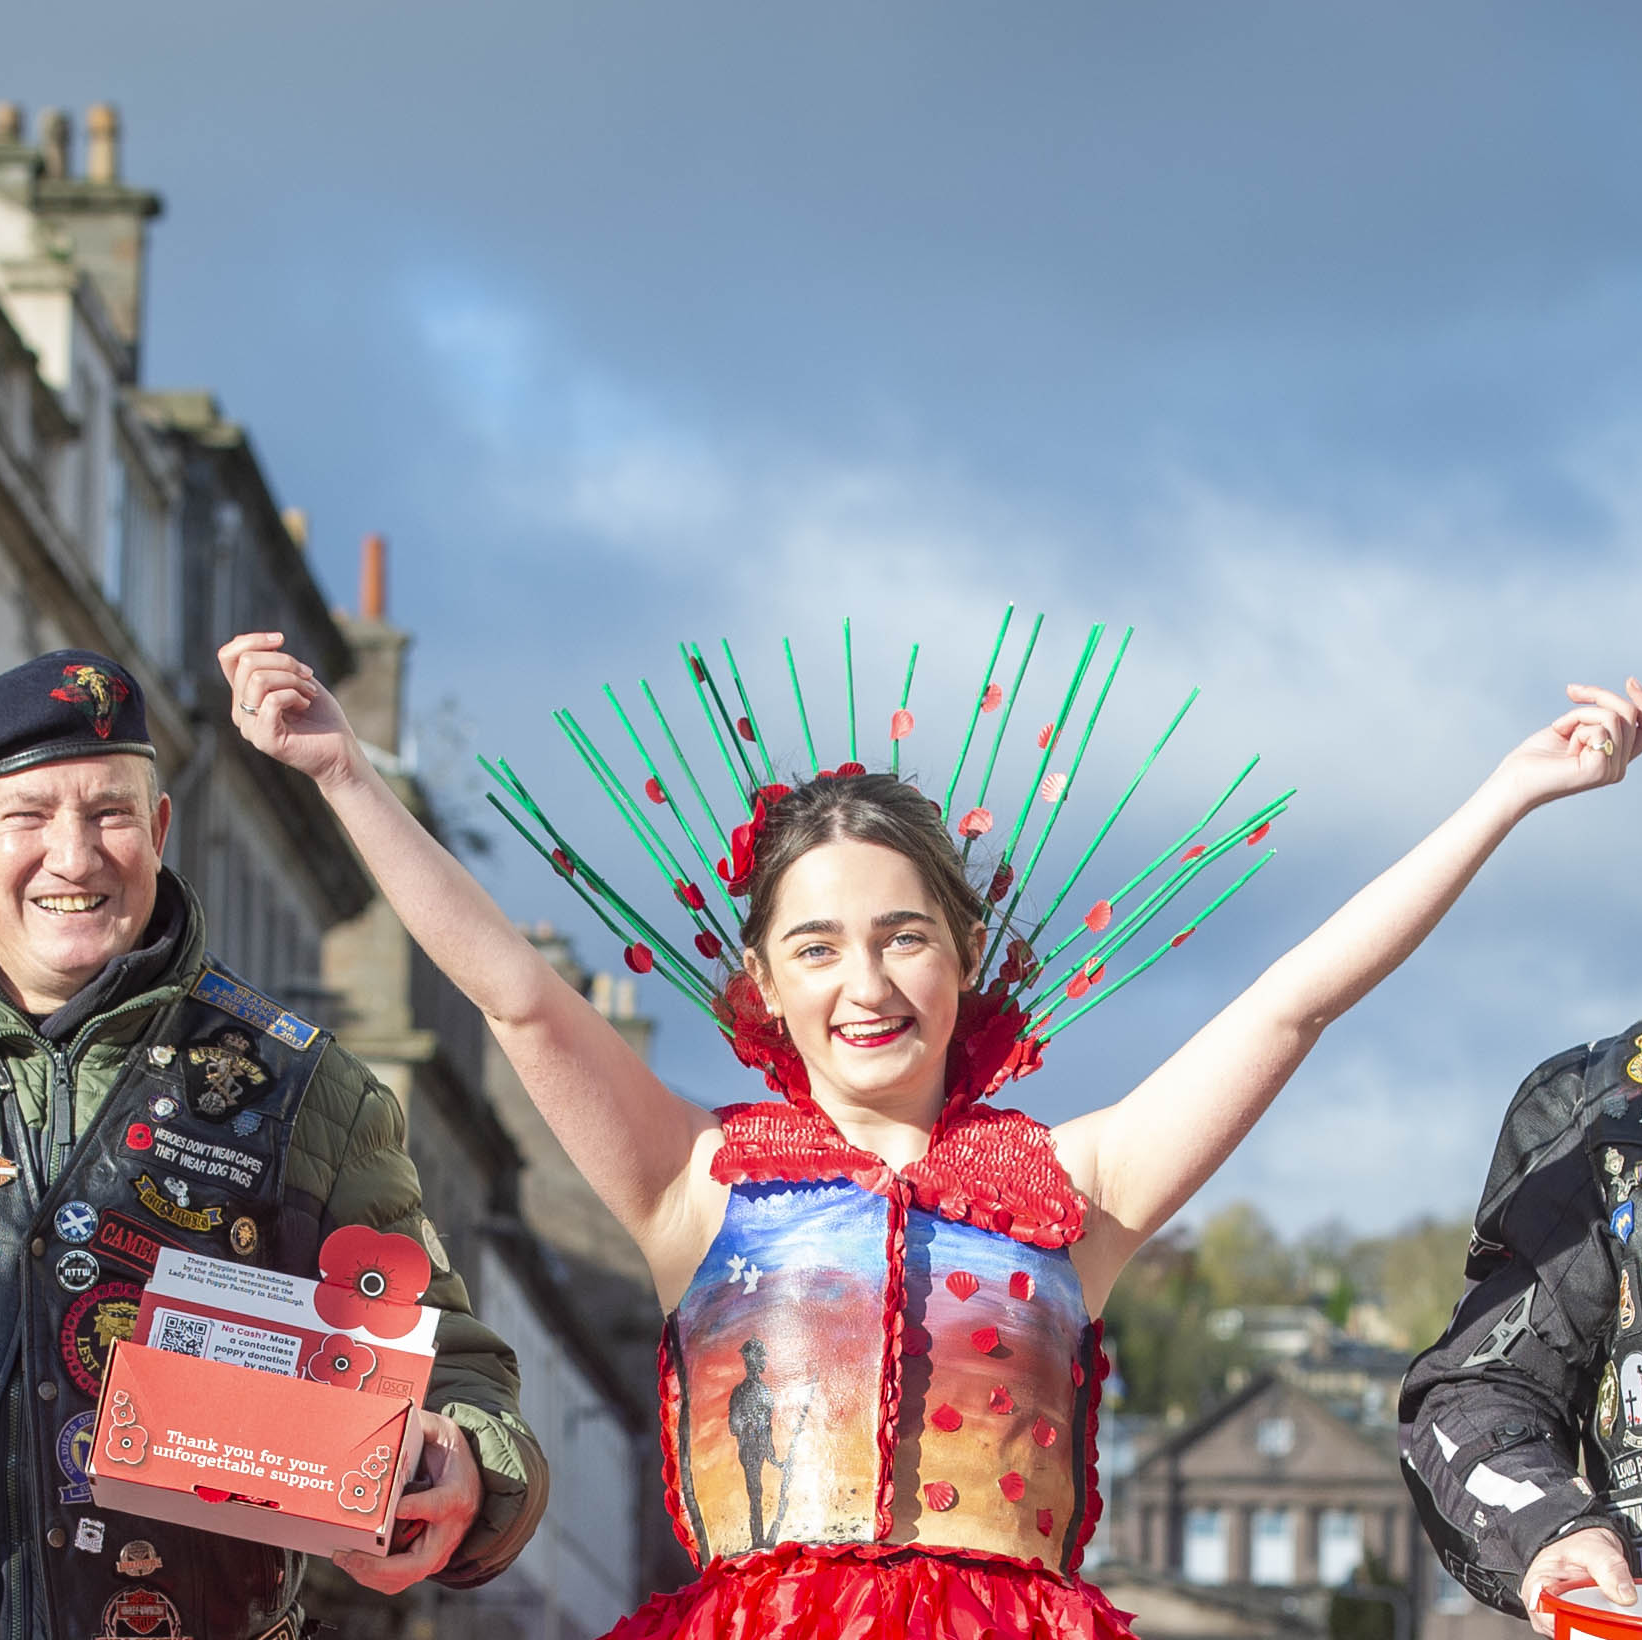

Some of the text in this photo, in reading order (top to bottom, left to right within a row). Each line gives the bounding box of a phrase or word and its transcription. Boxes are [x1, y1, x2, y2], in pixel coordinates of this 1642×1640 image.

[154, 1127, 263, 1173] HEROES DON'T WEAR CAPES
[154, 1143, 253, 1188] THEY WEAR DOG TAGS
[100, 1223, 160, 1265] CAMER
[168, 1268, 186, 1281] Lady
[187, 1272, 204, 1286] Haig
[206, 1276, 228, 1292] Poppy
[229, 1281, 256, 1298] Factory
[267, 1291, 304, 1308] Edinburgh
[187, 1256, 294, 1287] These Poppies were handmade
[208, 1269, 237, 1284] disabled
[240, 1277, 269, 1291] veterans
[221, 1324, 296, 1347] No Cash? Make
[238, 1339, 294, 1357] contactless
[76, 1335, 100, 1373] LEST
[214, 1343, 291, 1367] poppy donation
[382, 1379, 409, 1395] OSCR
[152, 1444, 336, 1492] unforgettable support
[166, 1429, 329, 1477] Thank you for your
[1614, 1460, 1637, 1480] LOUD
